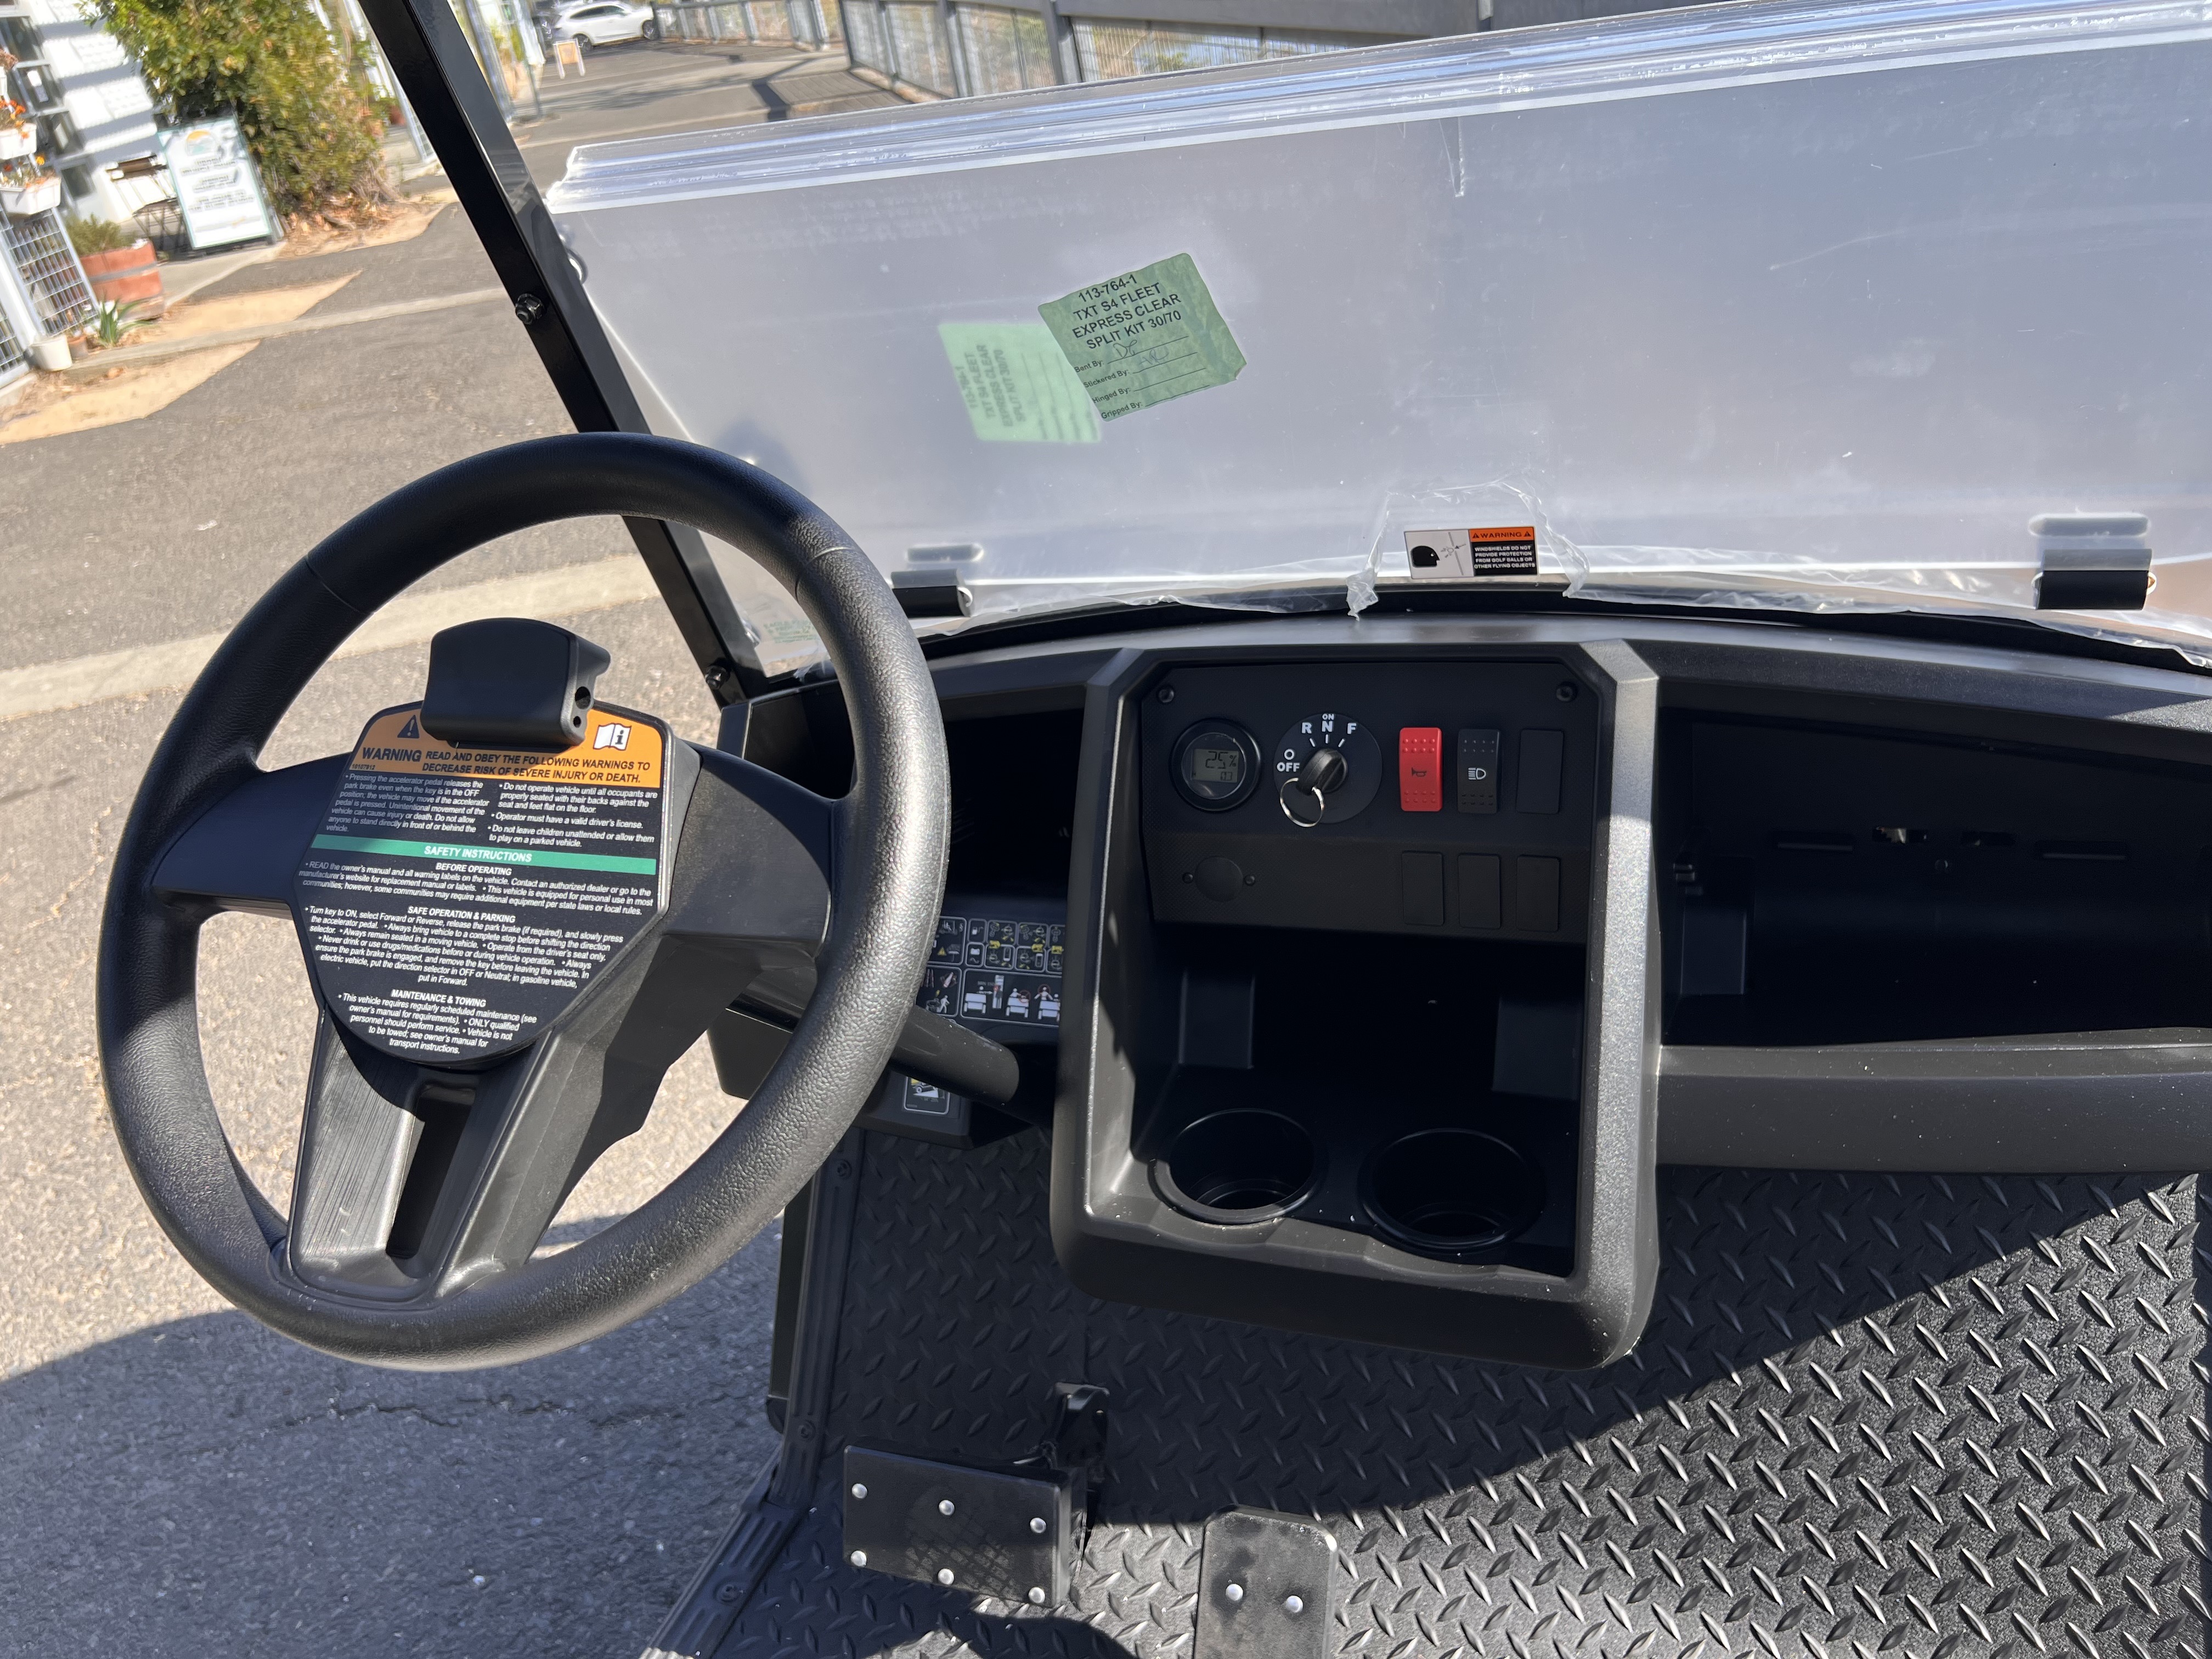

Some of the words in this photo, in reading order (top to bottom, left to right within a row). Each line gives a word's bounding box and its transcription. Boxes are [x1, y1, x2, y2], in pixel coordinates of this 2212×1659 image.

[1078, 274, 1137, 302] 113-764-1
[1073, 305, 1098, 320] TXT
[1101, 299, 1118, 312] S4
[1120, 282, 1161, 304] FLEET
[1072, 311, 1133, 338] EXPRESS
[1135, 293, 1182, 317] CLEAR
[1086, 330, 1121, 349] SPLIT
[1124, 321, 1146, 336] KIT
[1148, 311, 1181, 329] 30/70
[1074, 363, 1092, 373] Bent
[1091, 360, 1105, 368] By:
[1083, 373, 1116, 388] Stickered
[1092, 391, 1118, 403] Hinged
[1118, 387, 1131, 396] By:
[1101, 405, 1130, 419] Gripped
[1301, 722, 1312, 734] R
[1322, 721, 1333, 732] N
[1347, 723, 1357, 735] F
[362, 747, 422, 762] WARNING
[425, 751, 451, 760] READ
[452, 752, 472, 761] AND
[474, 753, 501, 763] OBEY
[503, 754, 521, 764] THE
[522, 755, 579, 766] FOLLOWING
[582, 759, 634, 769] WARNINGS
[637, 761, 650, 770] TO
[422, 763, 472, 773] DECREASE
[473, 765, 496, 774] RISK
[498, 766, 512, 775] OF
[512, 766, 551, 777] SEVERE
[552, 770, 587, 780] INJURY
[589, 772, 603, 781] OR
[606, 772, 640, 782] DEATH.
[1277, 762, 1300, 772] OFF
[349, 773, 376, 782] Pressing
[500, 793, 529, 801] properly
[586, 796, 608, 804] backs
[609, 798, 636, 806] against
[636, 799, 649, 807] the
[579, 805, 598, 813] floor.
[495, 812, 527, 821] Operator
[545, 815, 563, 823] have
[588, 818, 615, 826] driver's
[616, 820, 643, 828] license.
[496, 834, 513, 843] play
[556, 838, 582, 847] vehicle.
[515, 826, 535, 834] leave
[536, 827, 564, 836] children
[565, 831, 606, 839] unattended
[635, 834, 654, 842] them
[424, 845, 461, 856] SAFETY
[461, 848, 532, 862] INSTRUCTIONS
[435, 862, 467, 871] BEFORE
[467, 865, 512, 875] OPERATING
[407, 906, 428, 915] SAFE
[428, 908, 473, 919] OPERATION
[480, 912, 516, 923] PARKING
[438, 975, 467, 985] Forward.
[391, 989, 447, 1002] MAINTENANCE
[455, 996, 486, 1007] TOWING
[343, 993, 357, 1002] This
[358, 996, 381, 1005] vehicle
[381, 1000, 409, 1008] requires
[409, 1002, 439, 1013] regularly
[439, 1006, 476, 1015] scheduled
[475, 1011, 520, 1021] maintenance
[520, 1013, 537, 1023] (see
[349, 1005, 375, 1013] owner's
[375, 1008, 402, 1017] manual
[411, 1013, 460, 1025] requirements).
[468, 1018, 490, 1027] ONLY
[489, 1022, 520, 1031] qualified
[386, 1028, 409, 1038] towed;
[424, 1034, 450, 1042] owner's
[451, 1037, 478, 1046] manual
[477, 1039, 489, 1047] for
[389, 1037, 420, 1048] transport
[420, 1043, 460, 1053] instructions.
